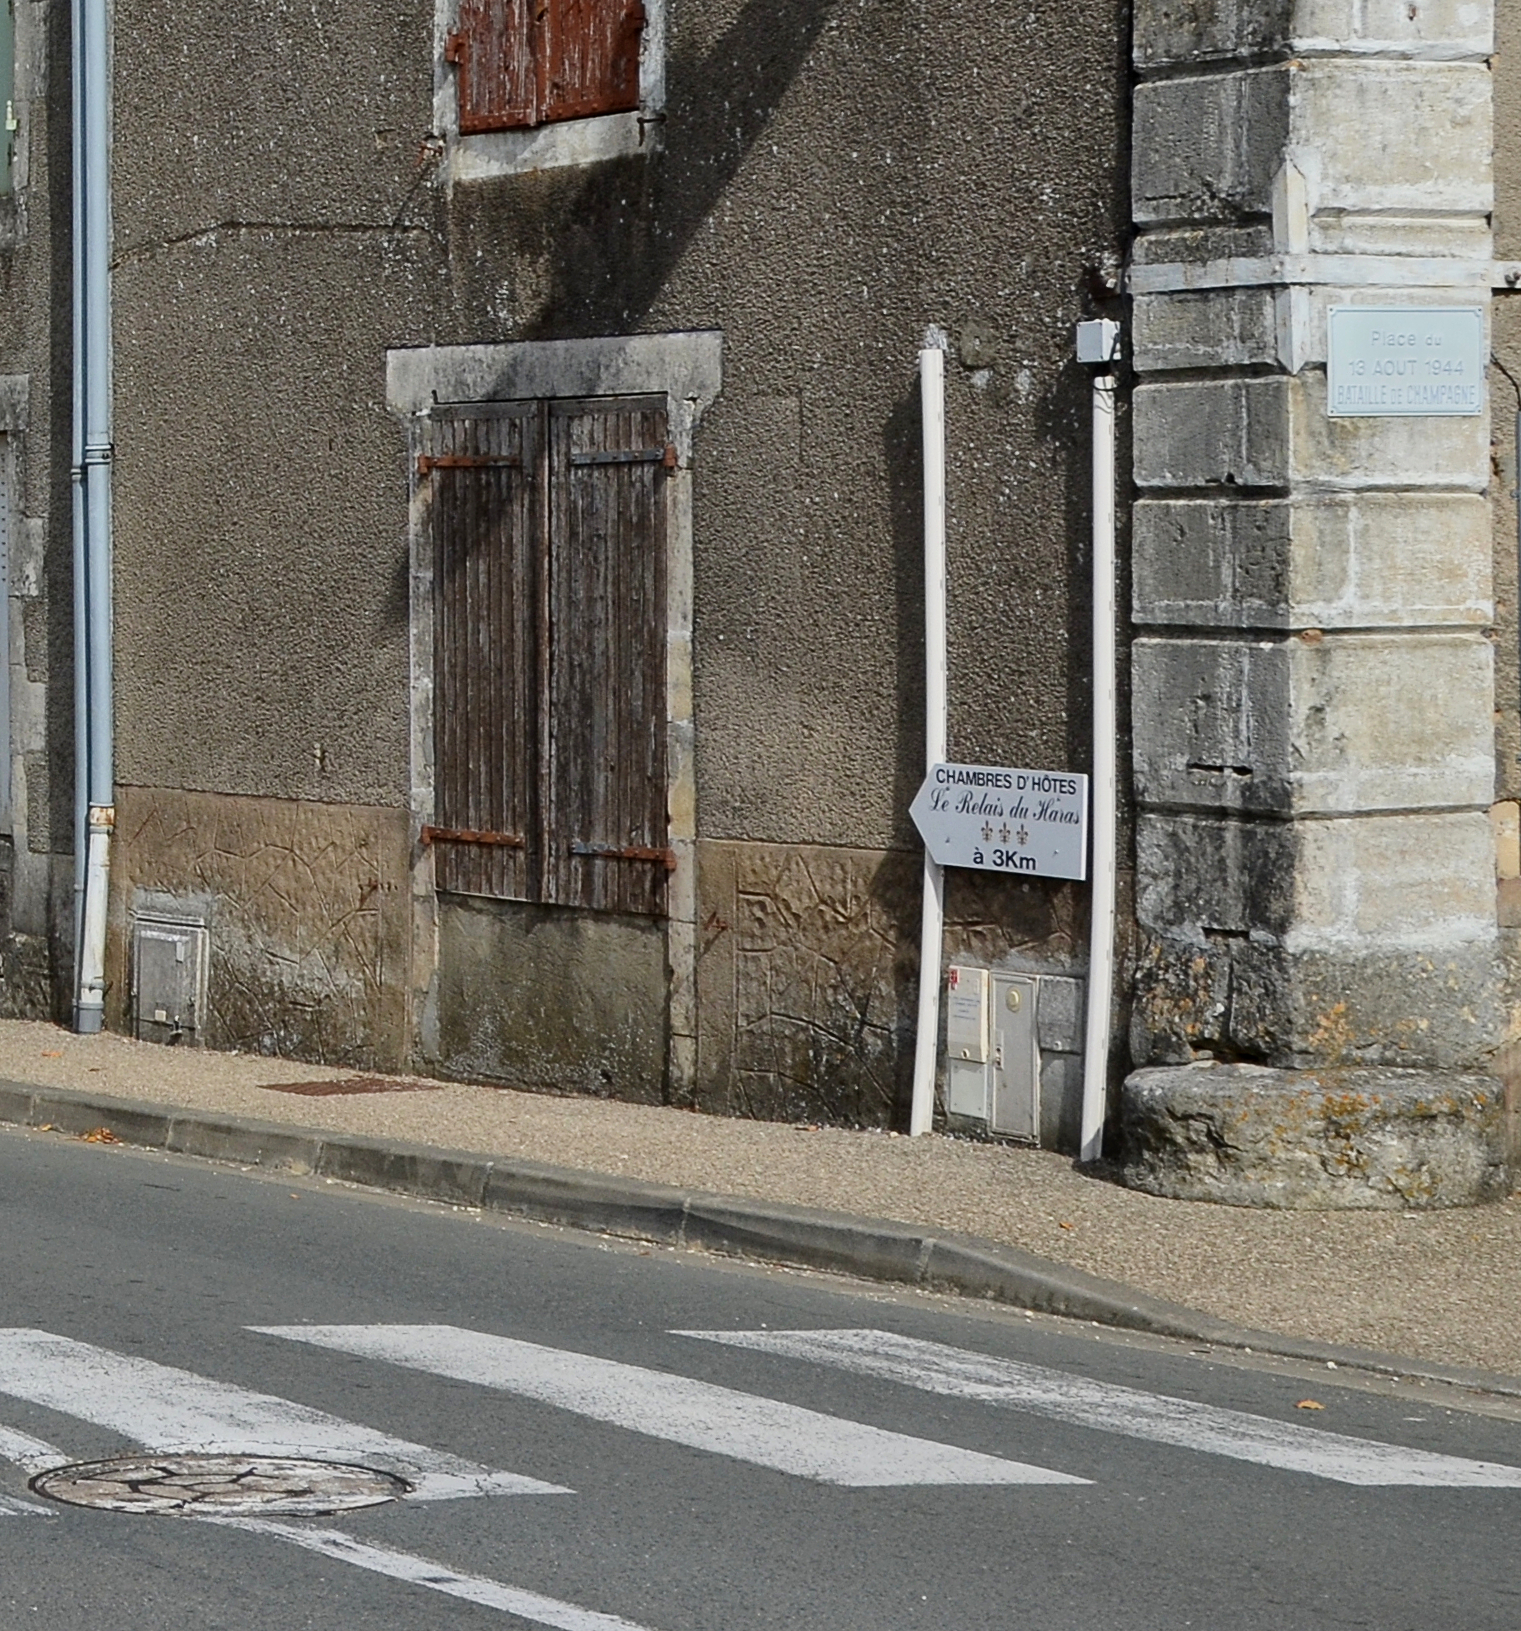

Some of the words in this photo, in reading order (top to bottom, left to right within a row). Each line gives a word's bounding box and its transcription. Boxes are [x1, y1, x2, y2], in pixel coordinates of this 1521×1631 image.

[1371, 331, 1416, 346] Place
[1425, 332, 1442, 346] du
[1348, 360, 1365, 376] 13
[1371, 360, 1417, 376] AOUT
[1424, 360, 1464, 376] 1944
[1337, 385, 1387, 405] BATAILLE
[1407, 385, 1476, 405] CHAMPAGNE
[935, 768, 1012, 790] CHAMBRES
[930, 787, 949, 812] Le
[955, 789, 1004, 817] Relais
[1009, 796, 1029, 820] du
[1032, 799, 1080, 825] Haras
[973, 847, 984, 865] à
[992, 849, 1037, 871] 3Km
